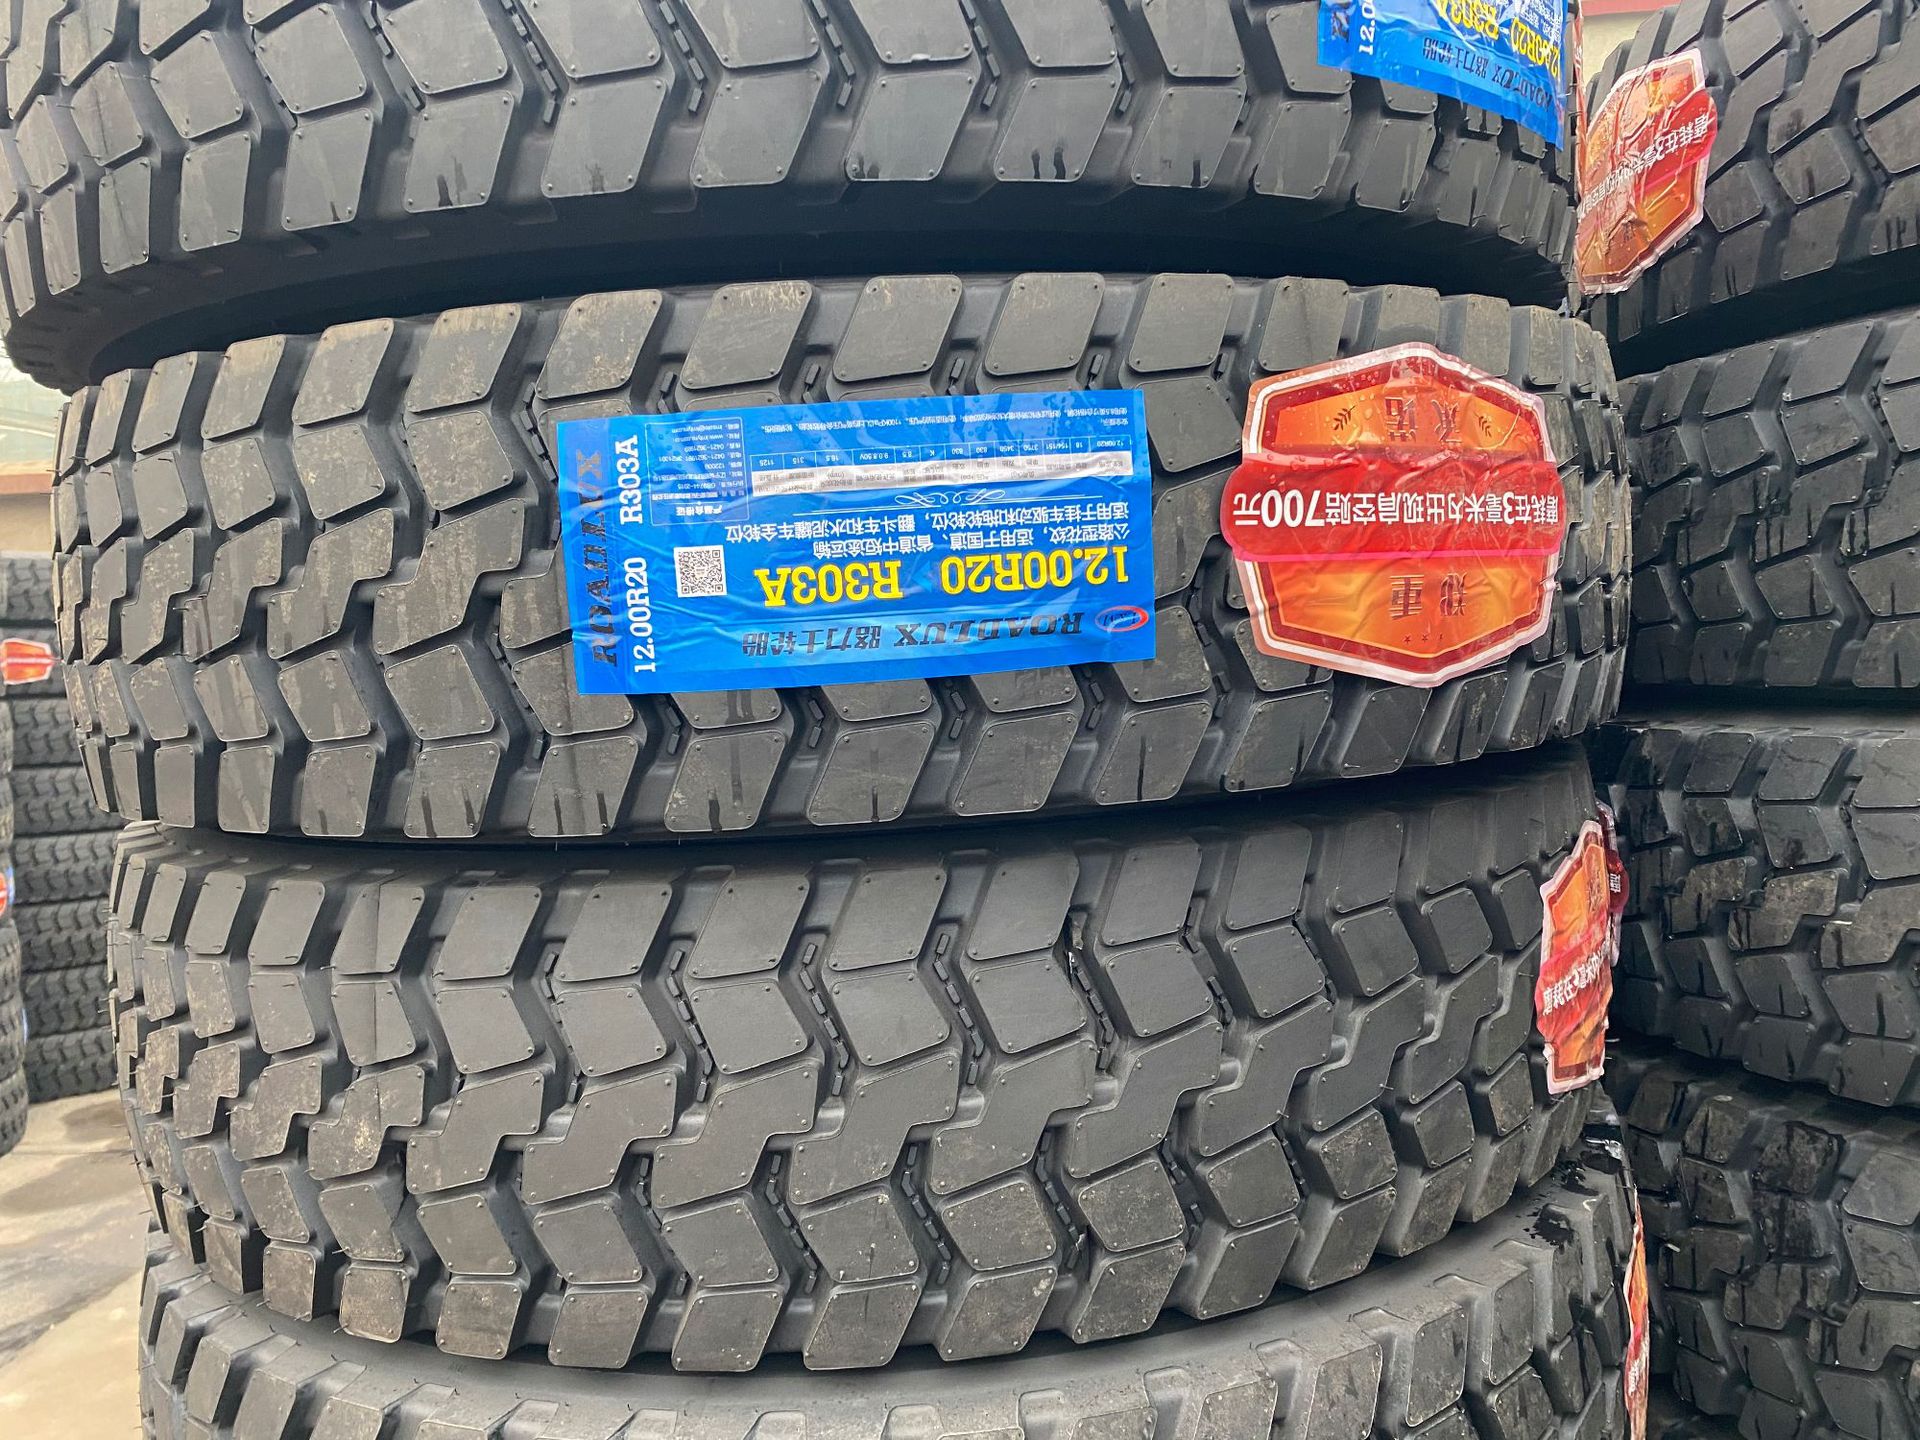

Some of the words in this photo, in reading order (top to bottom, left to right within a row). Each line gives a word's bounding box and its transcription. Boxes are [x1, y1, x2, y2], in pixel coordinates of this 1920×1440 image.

[615, 435, 643, 524] R303A
[1233, 489, 1558, 527] 磨耗在3毫米内出现肩空赔700元
[813, 523, 1130, 558] 公路型花纹，适用于国道、省道中短途运输
[755, 560, 903, 606] R303A
[941, 546, 1129, 593] 12.00R20
[624, 557, 656, 672] 12.00R20
[1389, 572, 1467, 620] 郑重
[742, 625, 881, 657] 路力士轮胎
[895, 612, 1084, 647] ROADLUX
